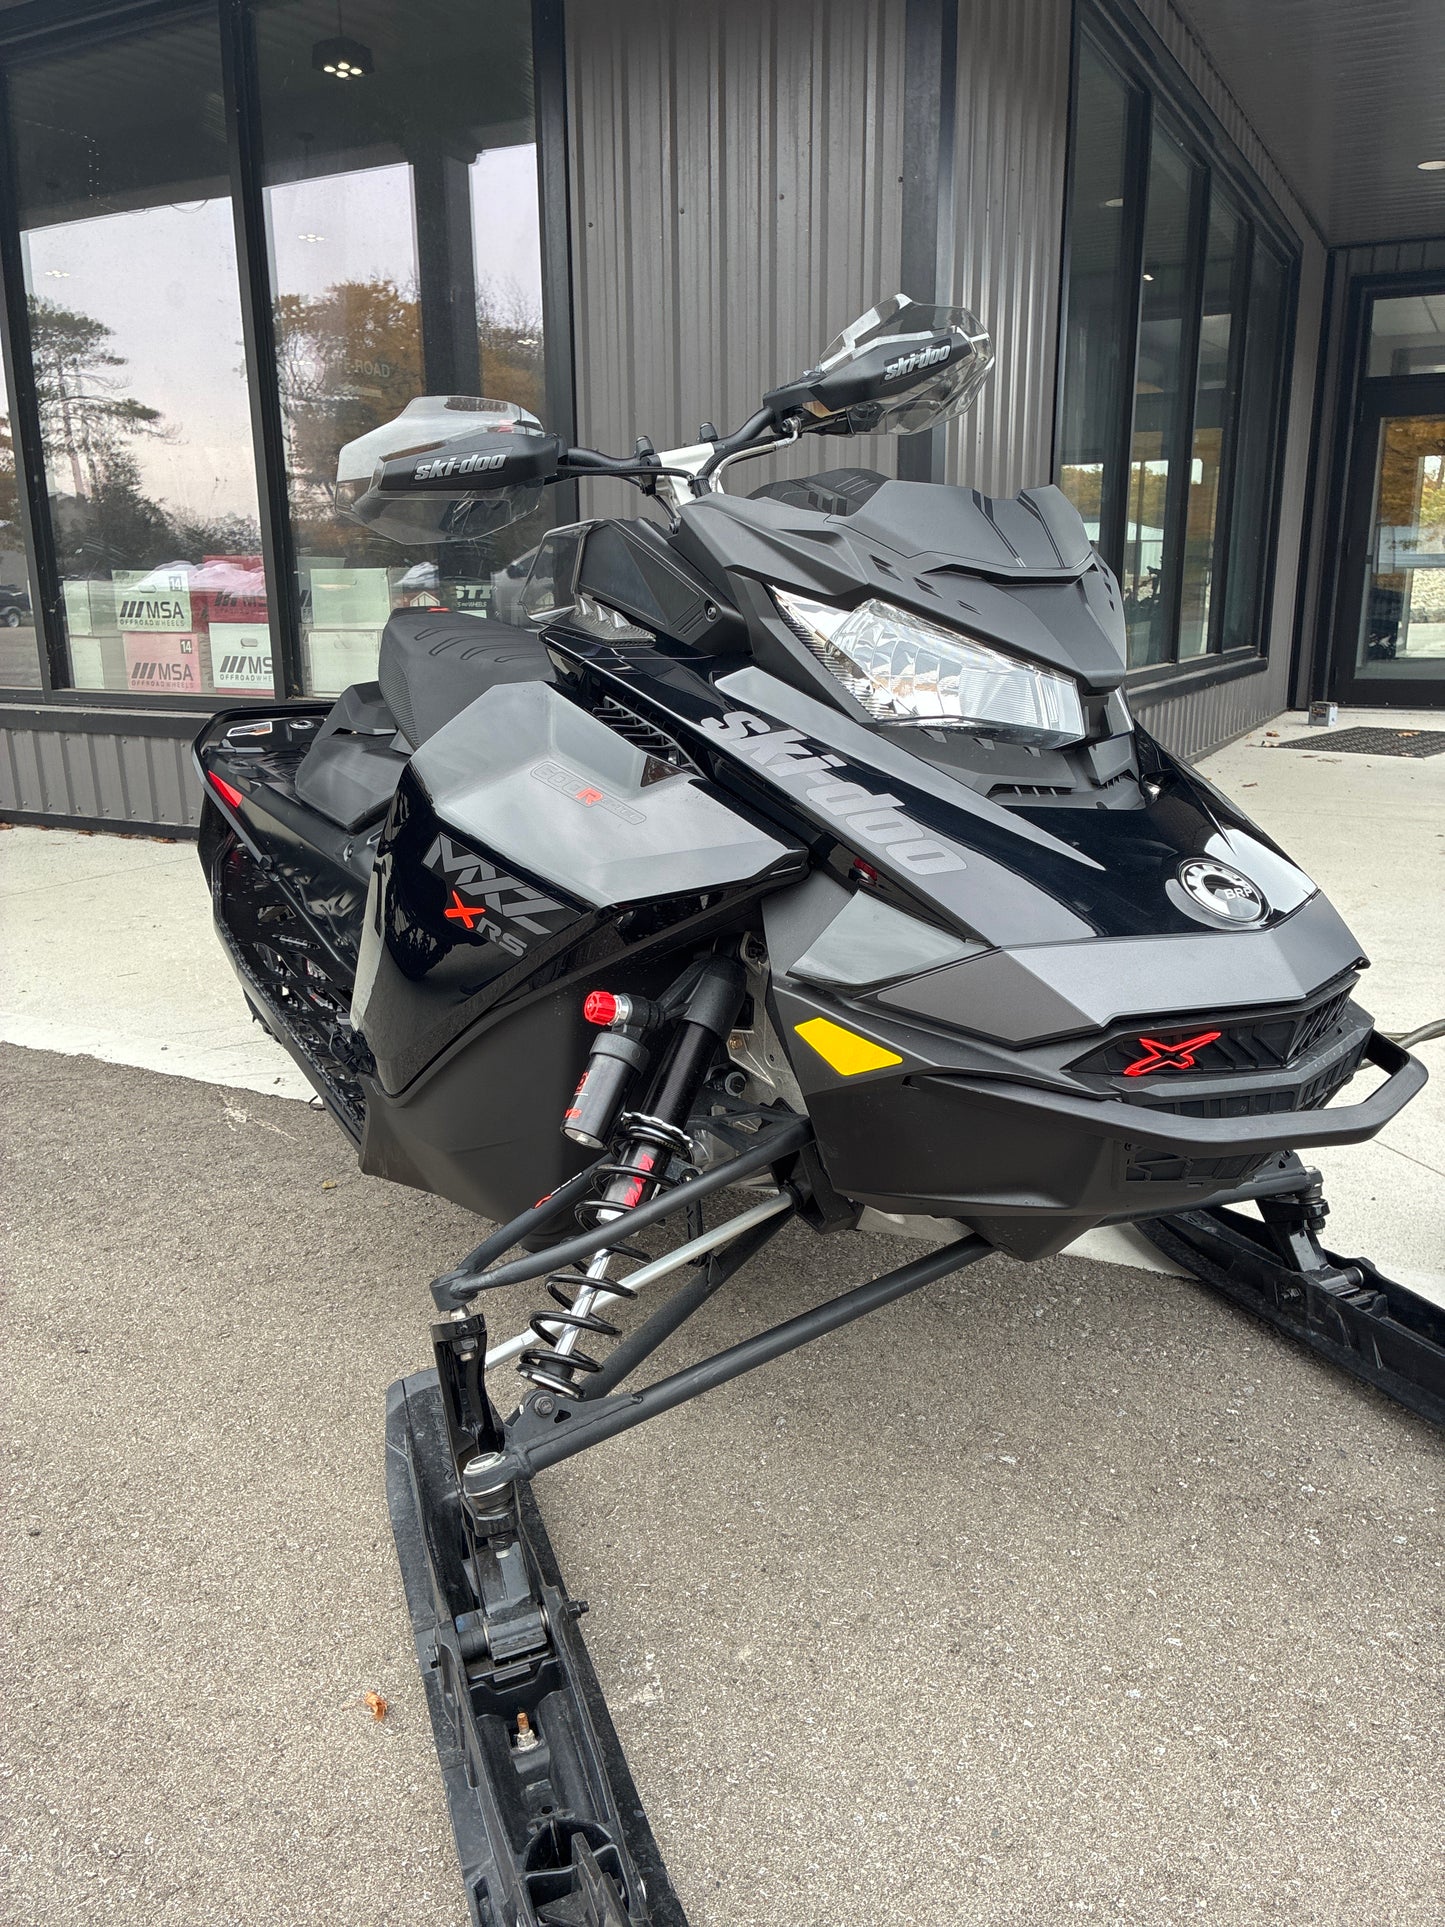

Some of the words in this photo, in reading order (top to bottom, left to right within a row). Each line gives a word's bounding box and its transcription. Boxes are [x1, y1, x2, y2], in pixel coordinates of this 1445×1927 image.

[884, 344, 951, 380] ski-doo
[414, 454, 506, 480] ski-doo
[170, 577, 182, 590] 14
[147, 601, 184, 619] MSA
[181, 640, 192, 653] 14
[158, 663, 194, 681] MSA
[248, 656, 273, 674] MS
[219, 673, 273, 682] OFFROADWHE
[1223, 887, 1253, 899] BRP
[476, 917, 528, 957] RS
